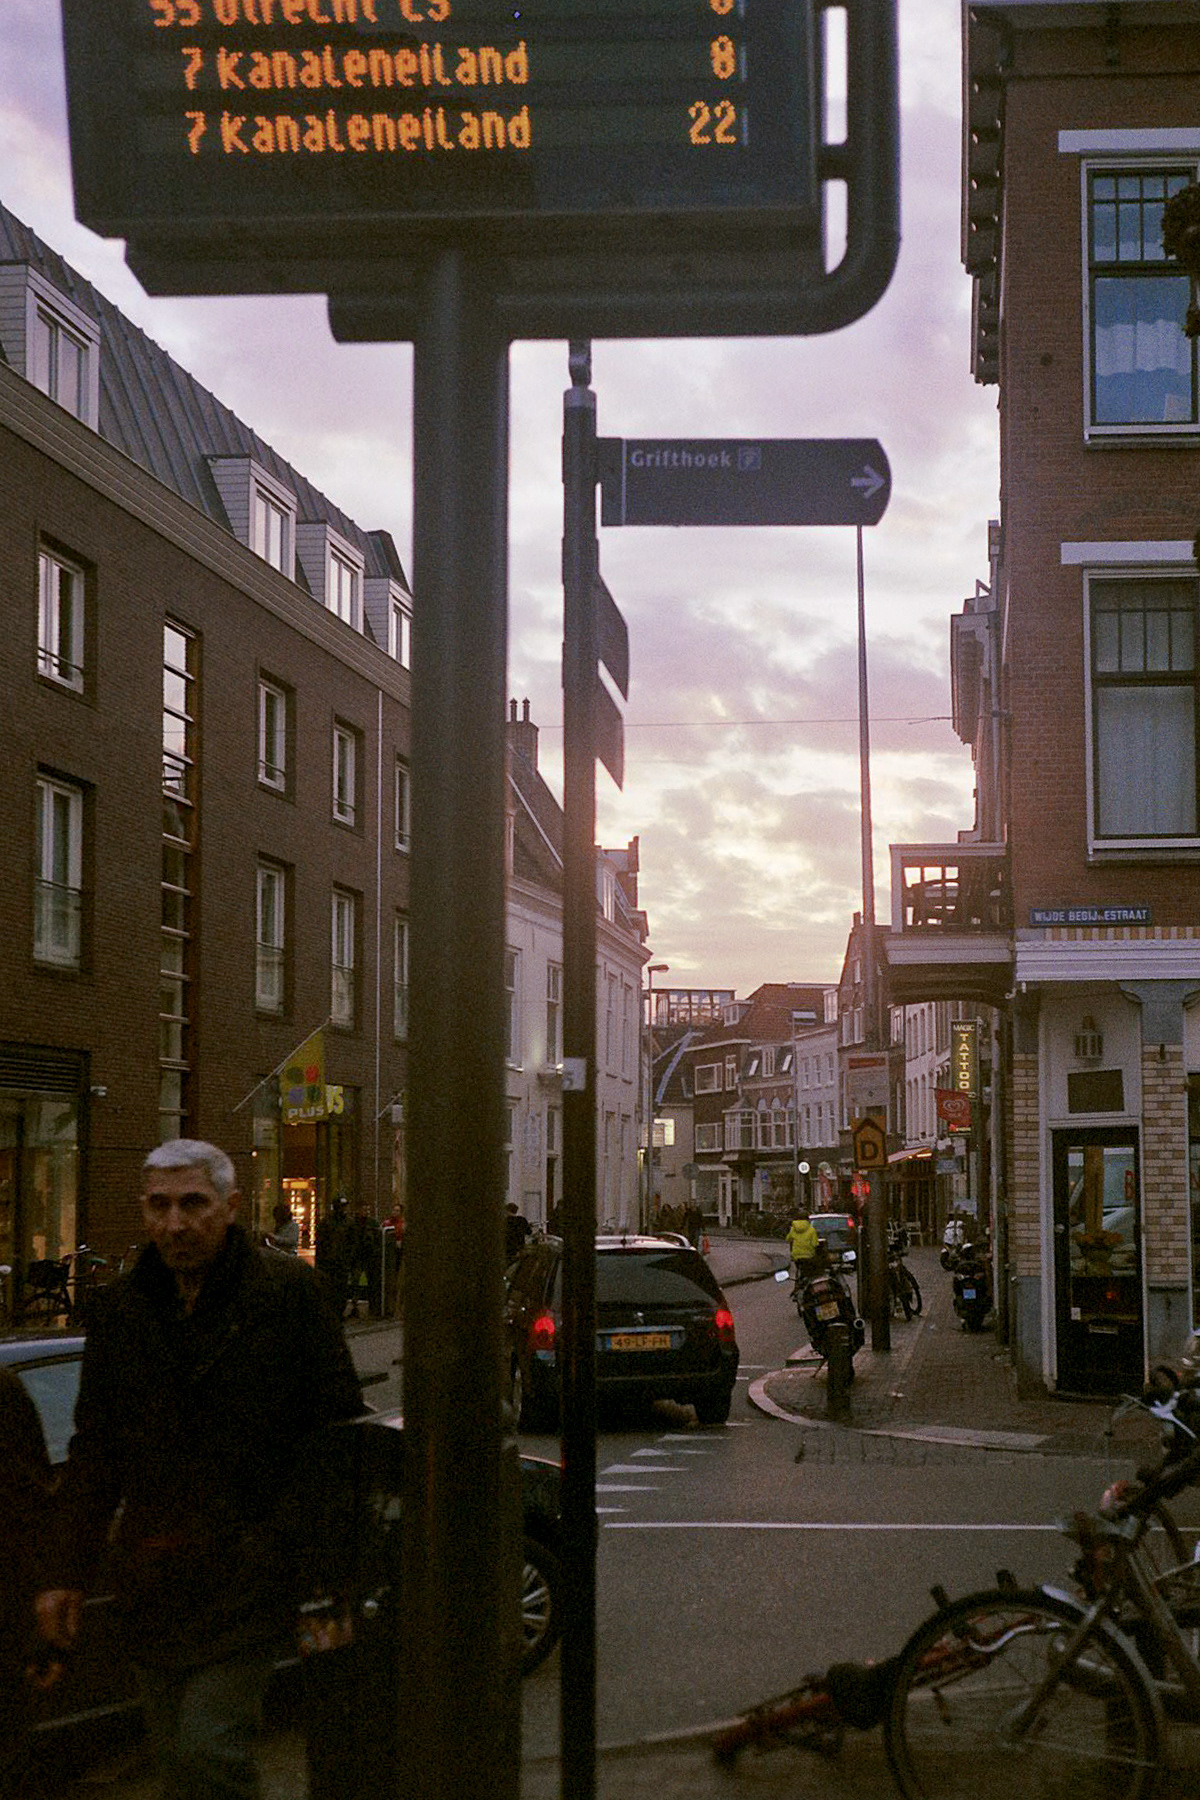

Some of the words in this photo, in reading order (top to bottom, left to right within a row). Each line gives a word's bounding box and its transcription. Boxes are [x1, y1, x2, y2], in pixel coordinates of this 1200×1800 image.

[181, 47, 203, 90] 7
[710, 35, 735, 80] 8
[184, 111, 207, 154] 7
[688, 100, 737, 145] 22
[630, 449, 732, 469] Grifthoek
[1034, 911, 1065, 922] WIJDE
[959, 1033, 970, 1090] TATTOO
[288, 1105, 325, 1119] PLUS
